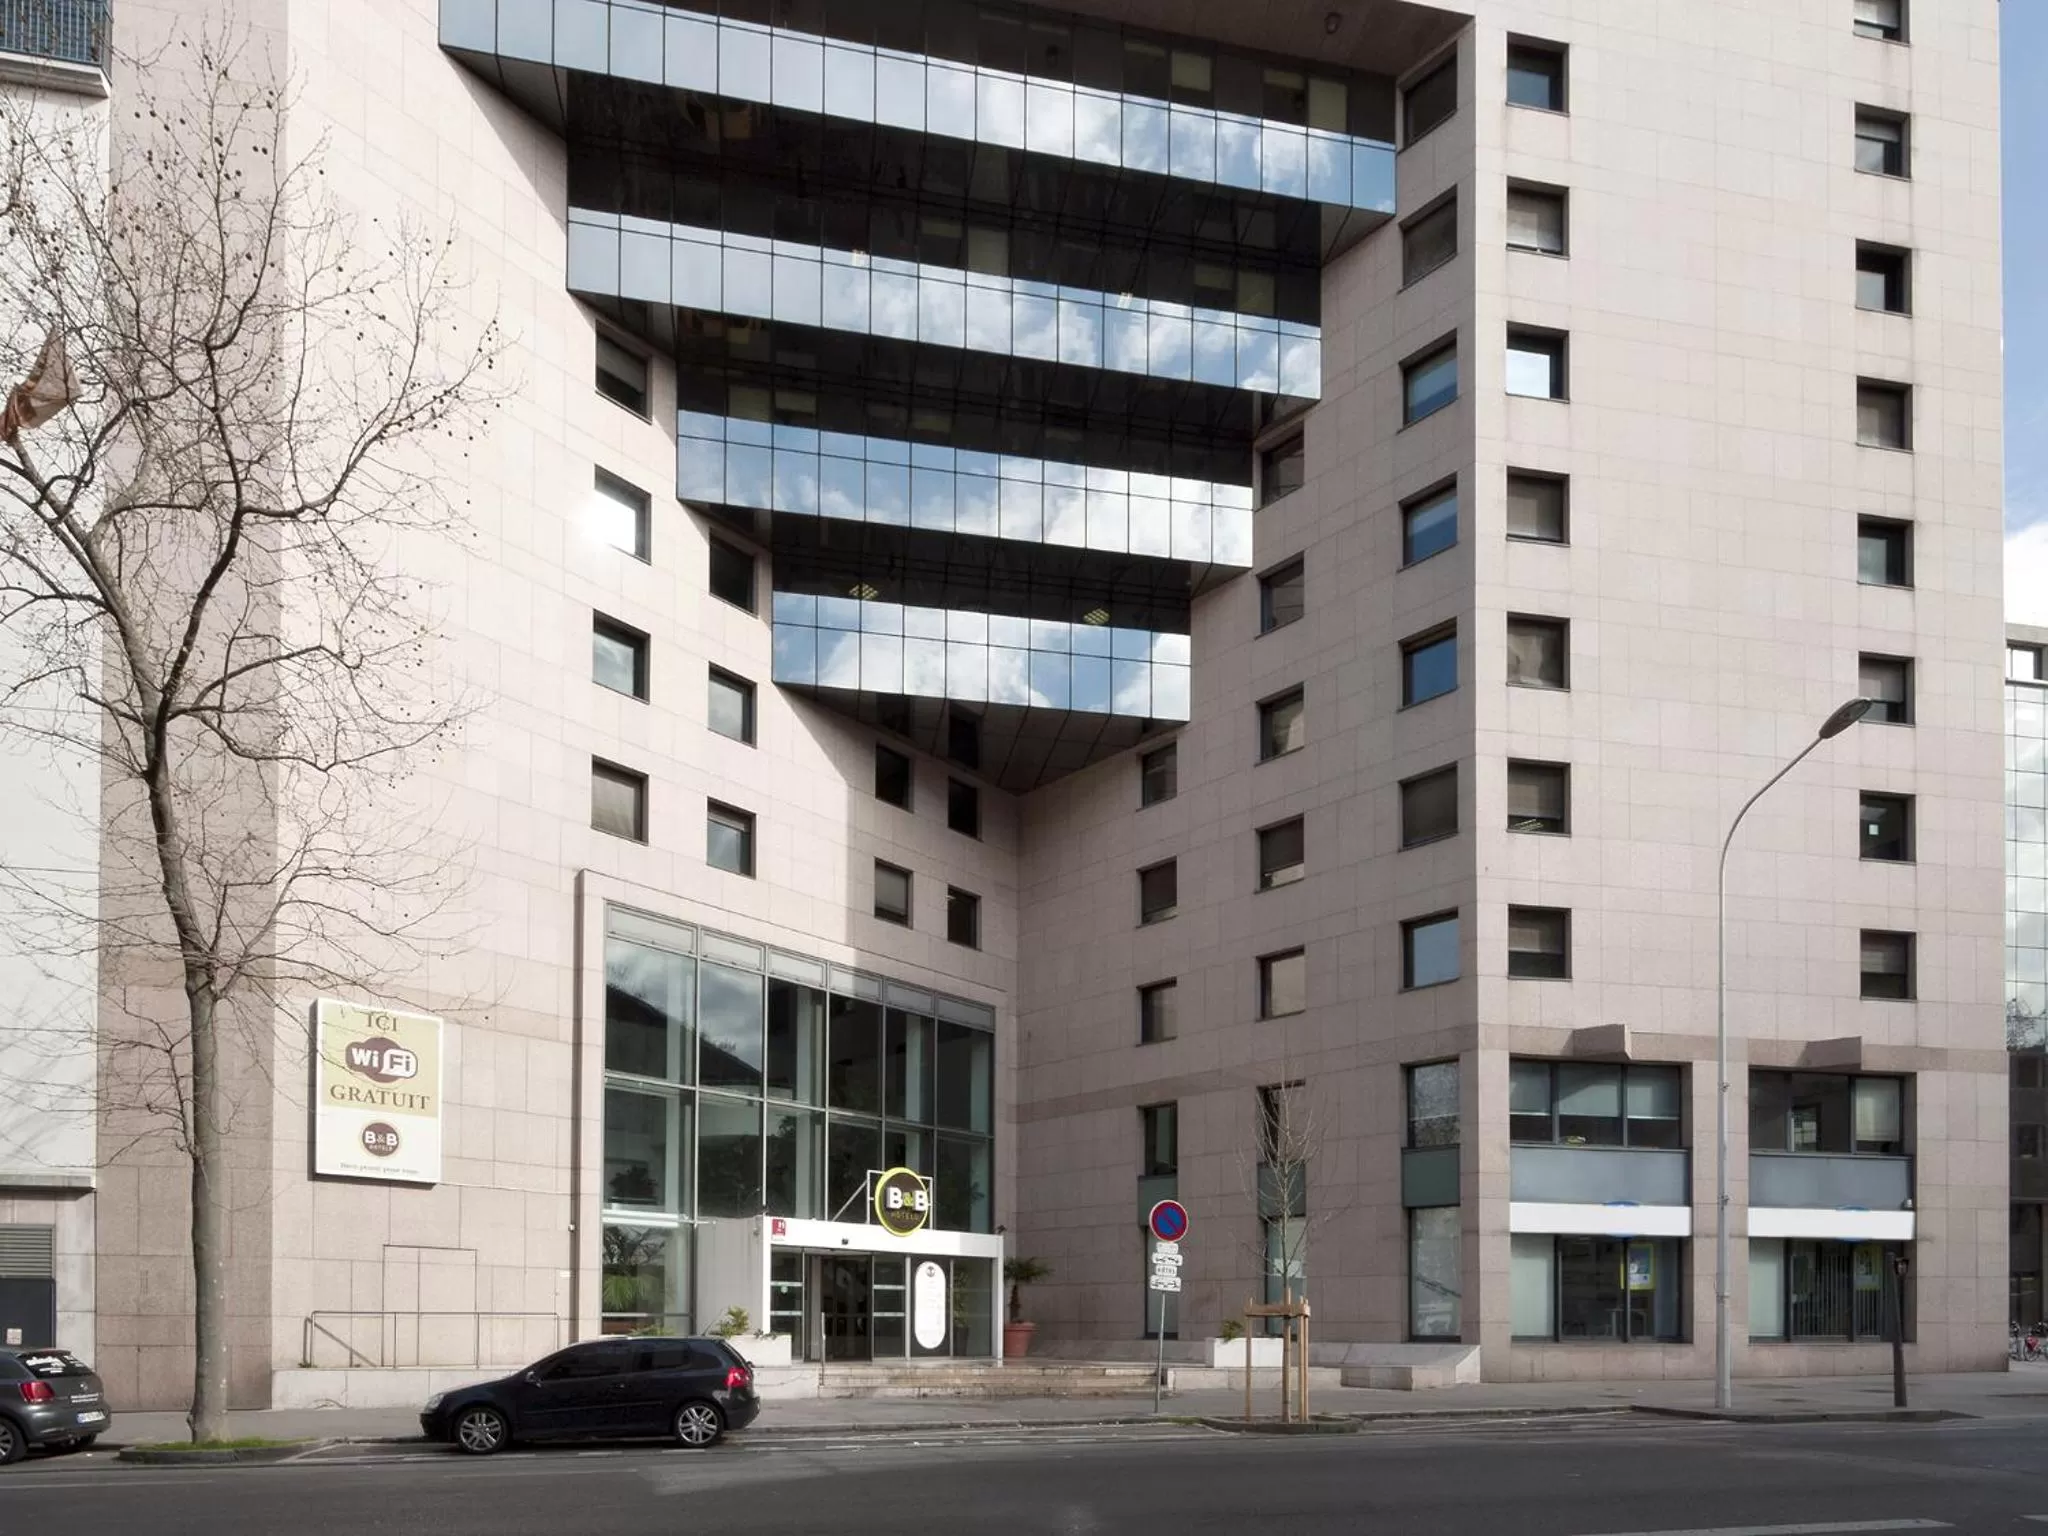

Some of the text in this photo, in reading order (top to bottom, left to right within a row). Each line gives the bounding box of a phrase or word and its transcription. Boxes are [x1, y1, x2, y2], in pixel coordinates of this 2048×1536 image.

[330, 1084, 430, 1110] GRATUIT
[365, 1131, 398, 1146] B&B
[887, 1187, 928, 1211] B&B
